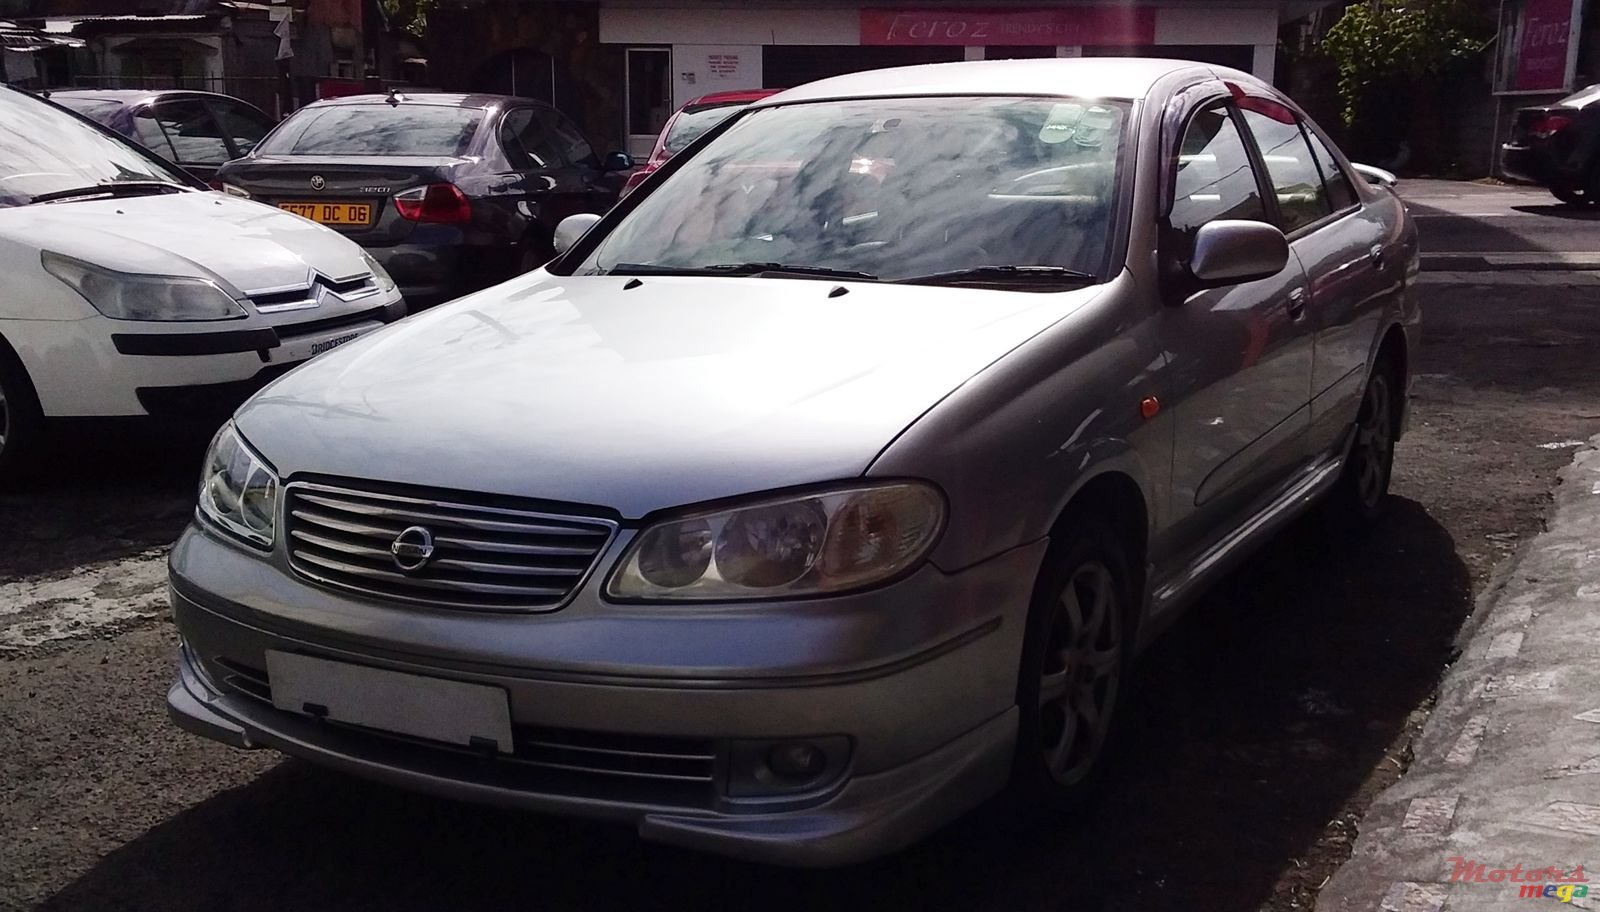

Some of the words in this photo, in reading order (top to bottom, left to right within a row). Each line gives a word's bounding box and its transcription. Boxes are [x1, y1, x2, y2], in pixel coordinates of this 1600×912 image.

[886, 14, 989, 41] Feroz
[323, 206, 340, 221] DC
[348, 206, 366, 222] 06
